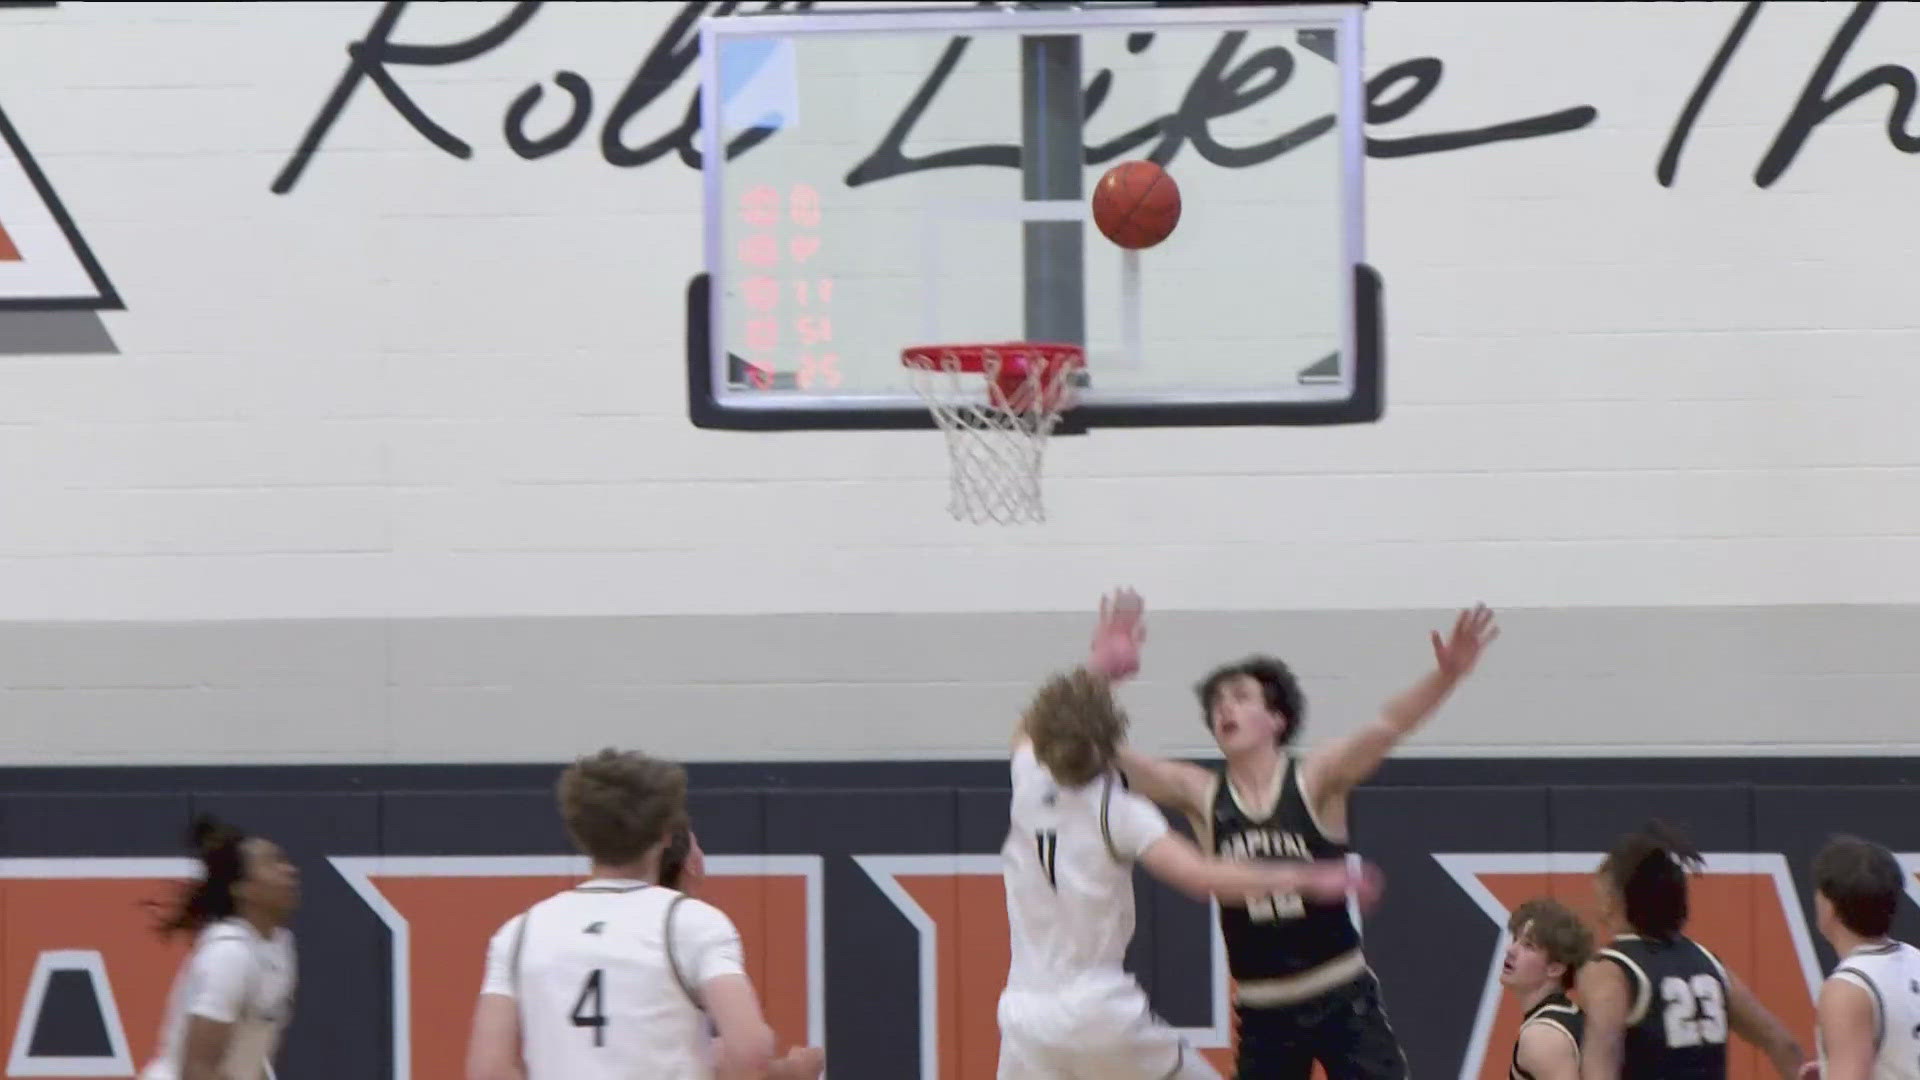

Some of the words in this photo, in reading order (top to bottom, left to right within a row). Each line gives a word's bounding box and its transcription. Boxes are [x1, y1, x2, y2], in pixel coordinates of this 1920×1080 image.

[845, 2, 1598, 188] Like
[568, 968, 608, 1048] 4
[1660, 974, 1727, 1048] 23
